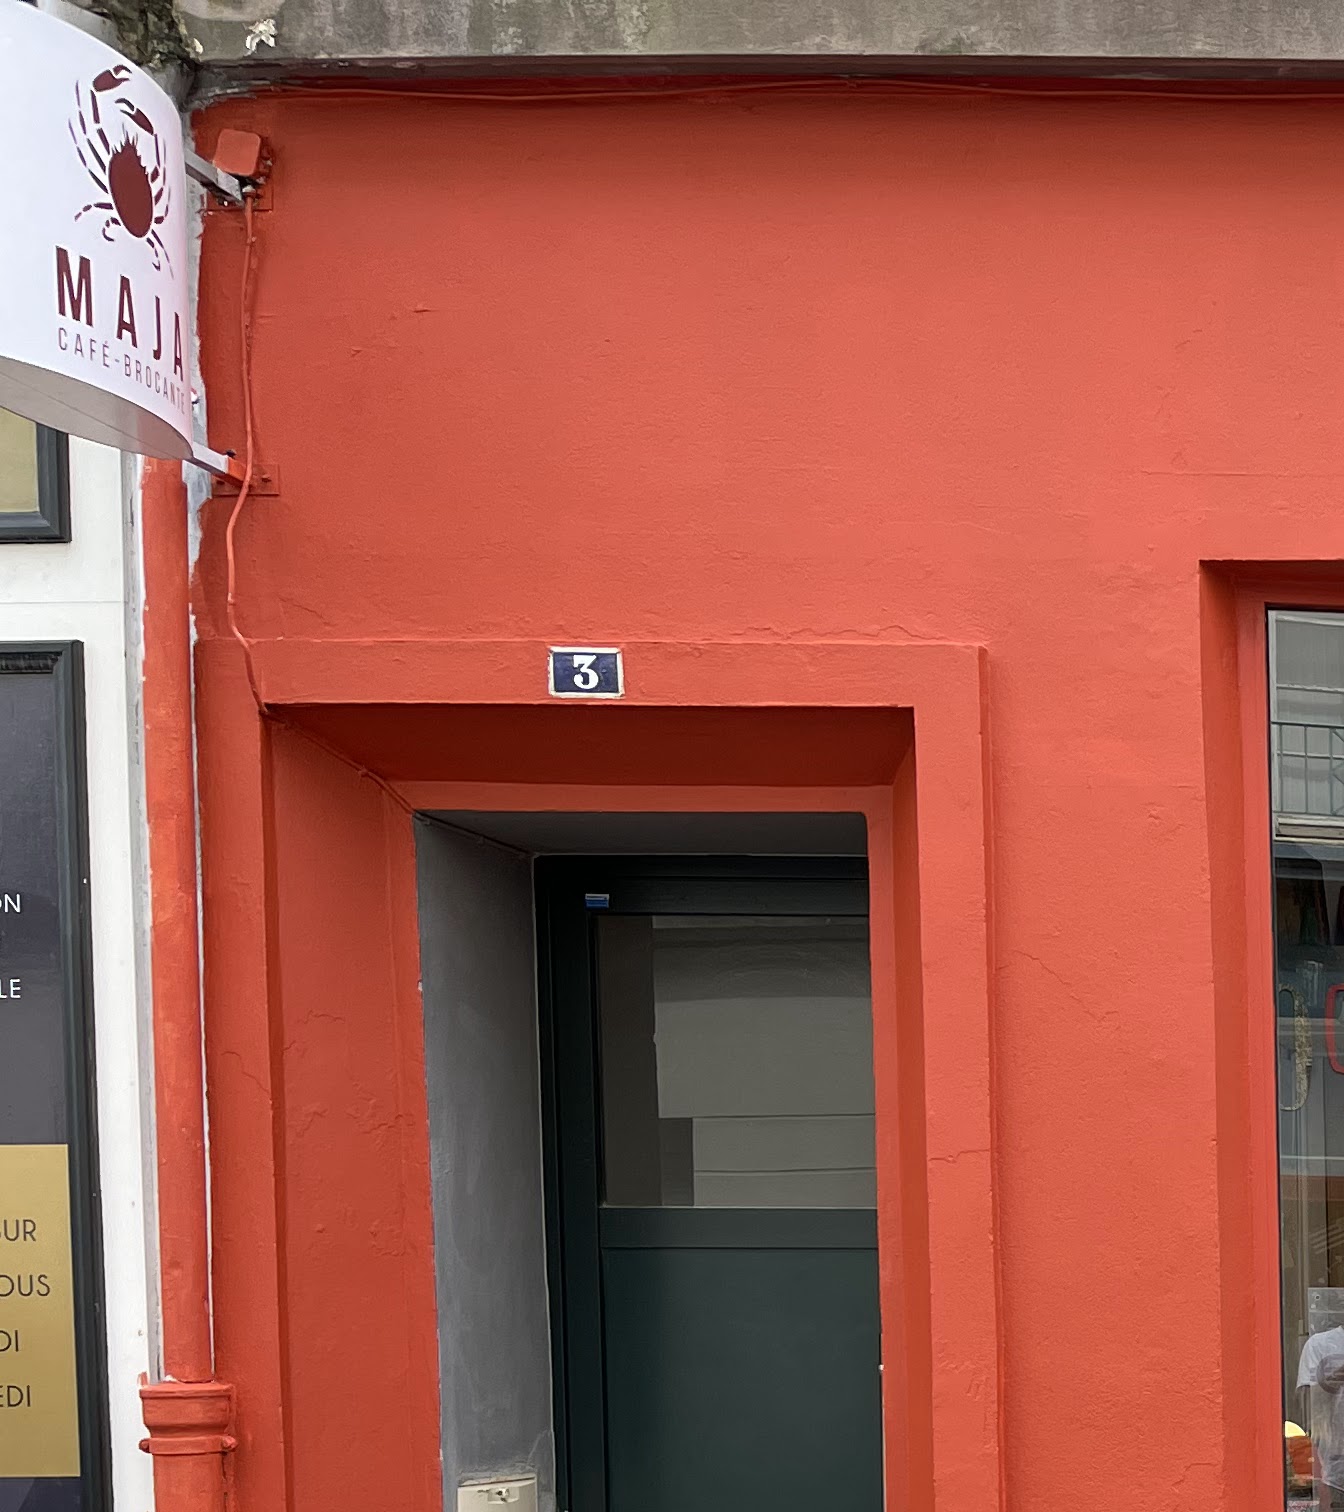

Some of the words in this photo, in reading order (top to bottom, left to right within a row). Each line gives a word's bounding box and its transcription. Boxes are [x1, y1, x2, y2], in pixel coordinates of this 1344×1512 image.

[55, 245, 183, 382] MAJA
[58, 327, 185, 415] CAFÉ-BROCANTE
[573, 654, 599, 690] 3
[0, 1218, 37, 1242] UR
